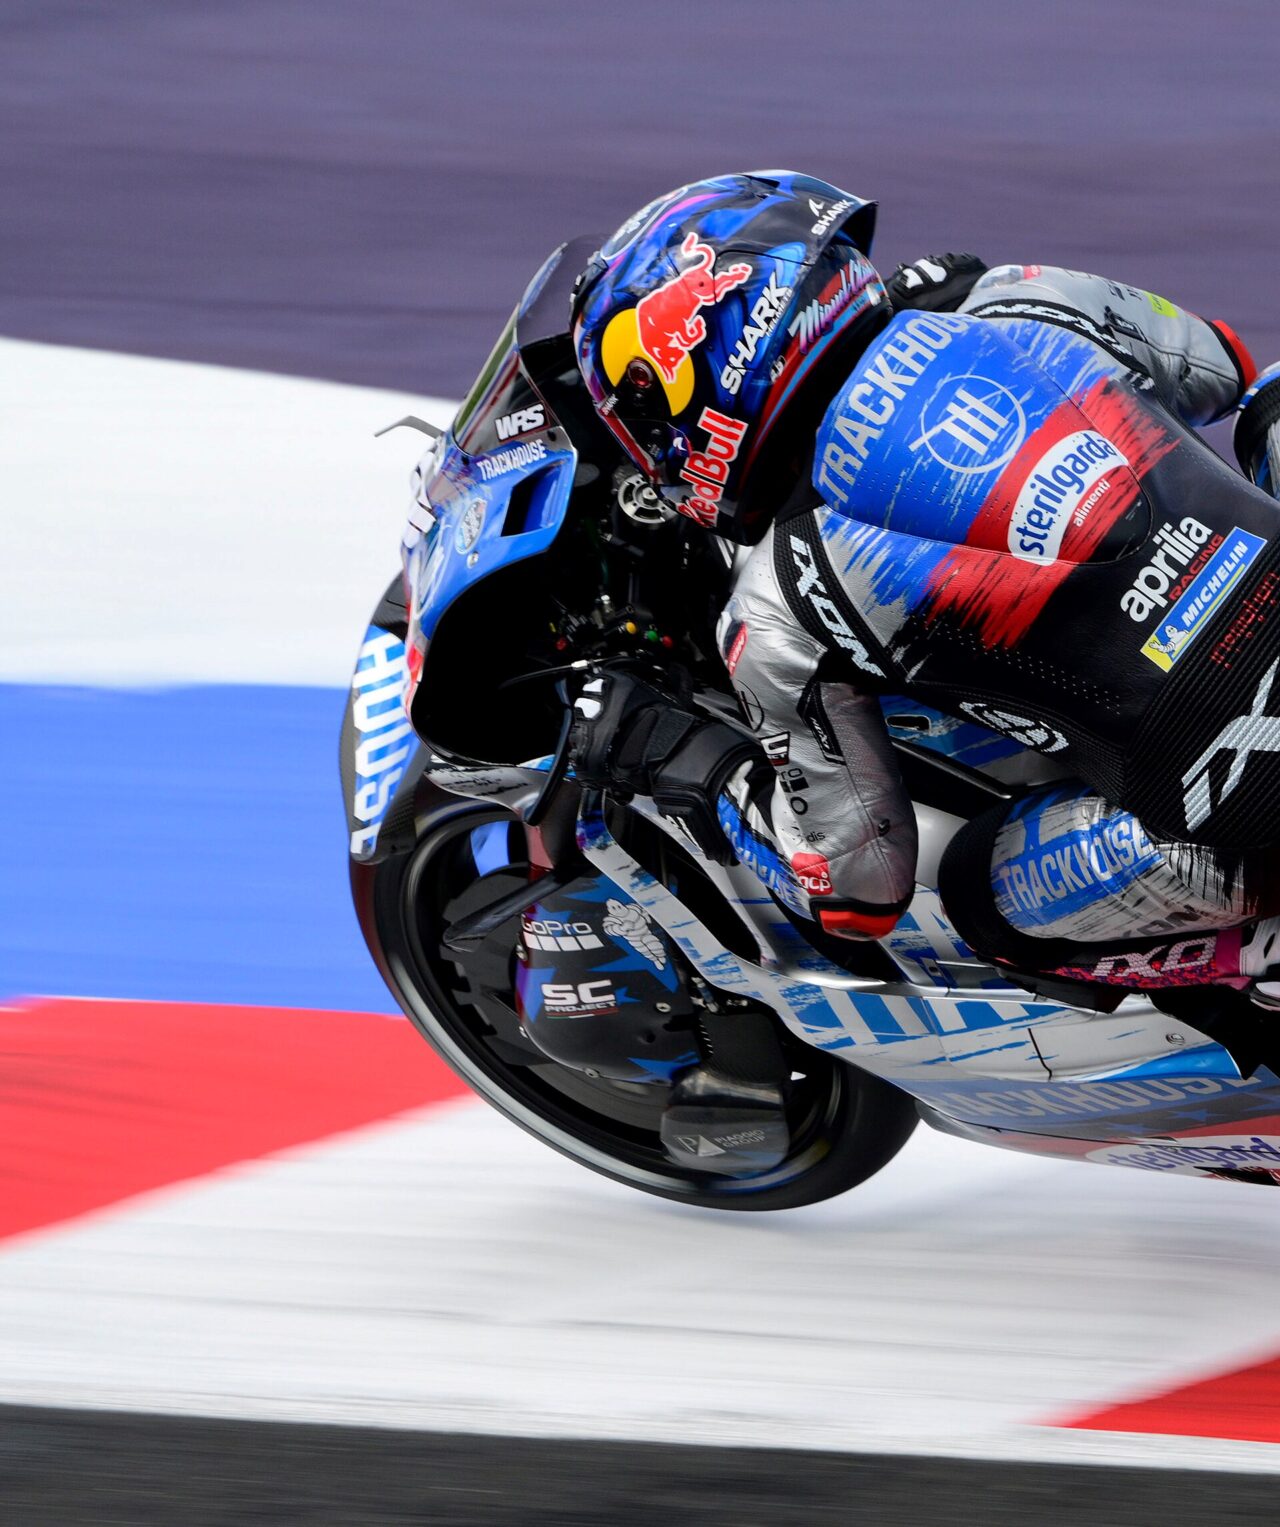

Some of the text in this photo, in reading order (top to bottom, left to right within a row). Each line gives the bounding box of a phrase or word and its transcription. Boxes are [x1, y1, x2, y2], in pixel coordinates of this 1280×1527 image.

[720, 271, 788, 395] SHARK
[495, 404, 545, 440] WRS
[684, 406, 749, 485] Bull
[476, 440, 547, 481] TRACKHOUSE
[1019, 436, 1116, 556] sterilgarda
[1073, 479, 1111, 527] alimenti
[1120, 516, 1213, 622] aprilia
[1168, 533, 1225, 601] RACING
[1181, 541, 1248, 627] MICHELIN
[541, 979, 616, 1006] SC
[544, 1001, 617, 1013] PROJECT
